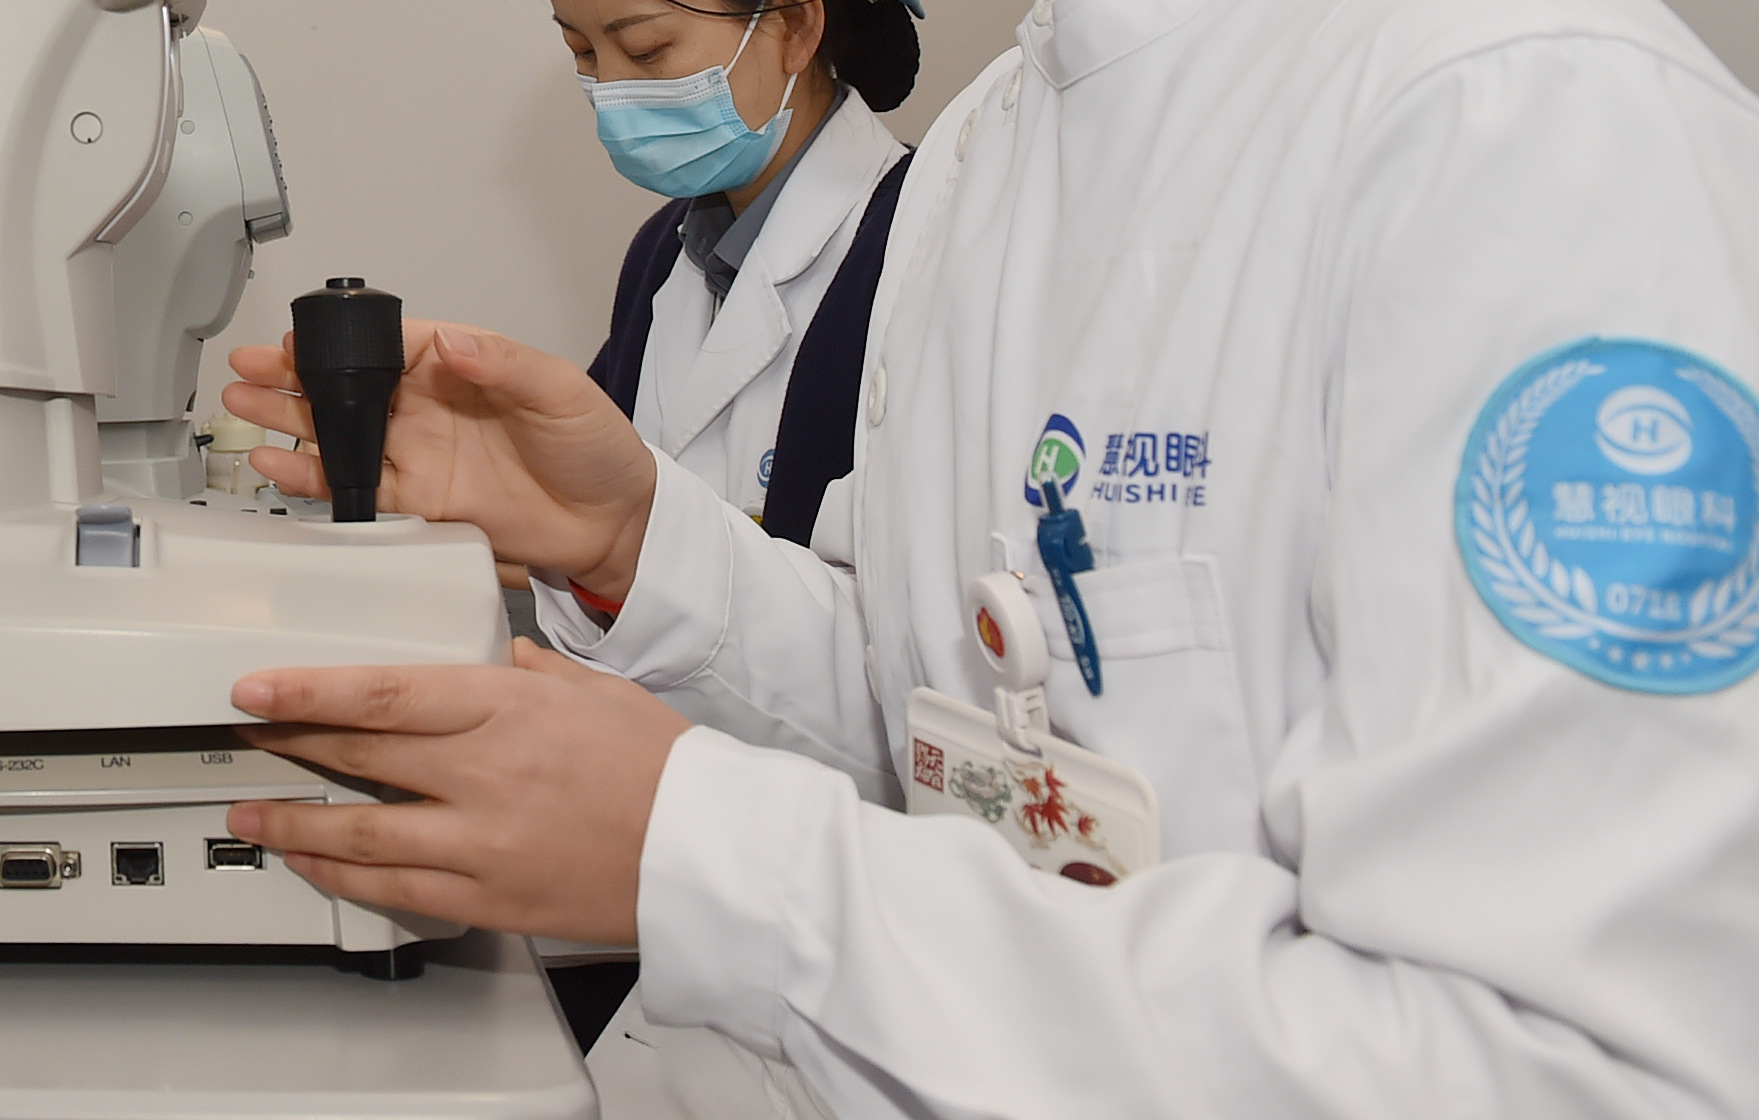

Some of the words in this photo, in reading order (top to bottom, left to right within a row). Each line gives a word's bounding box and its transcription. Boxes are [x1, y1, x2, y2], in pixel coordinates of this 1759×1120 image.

[1632, 418, 1659, 443] H
[101, 756, 131, 768] LAN
[201, 752, 233, 765] USB
